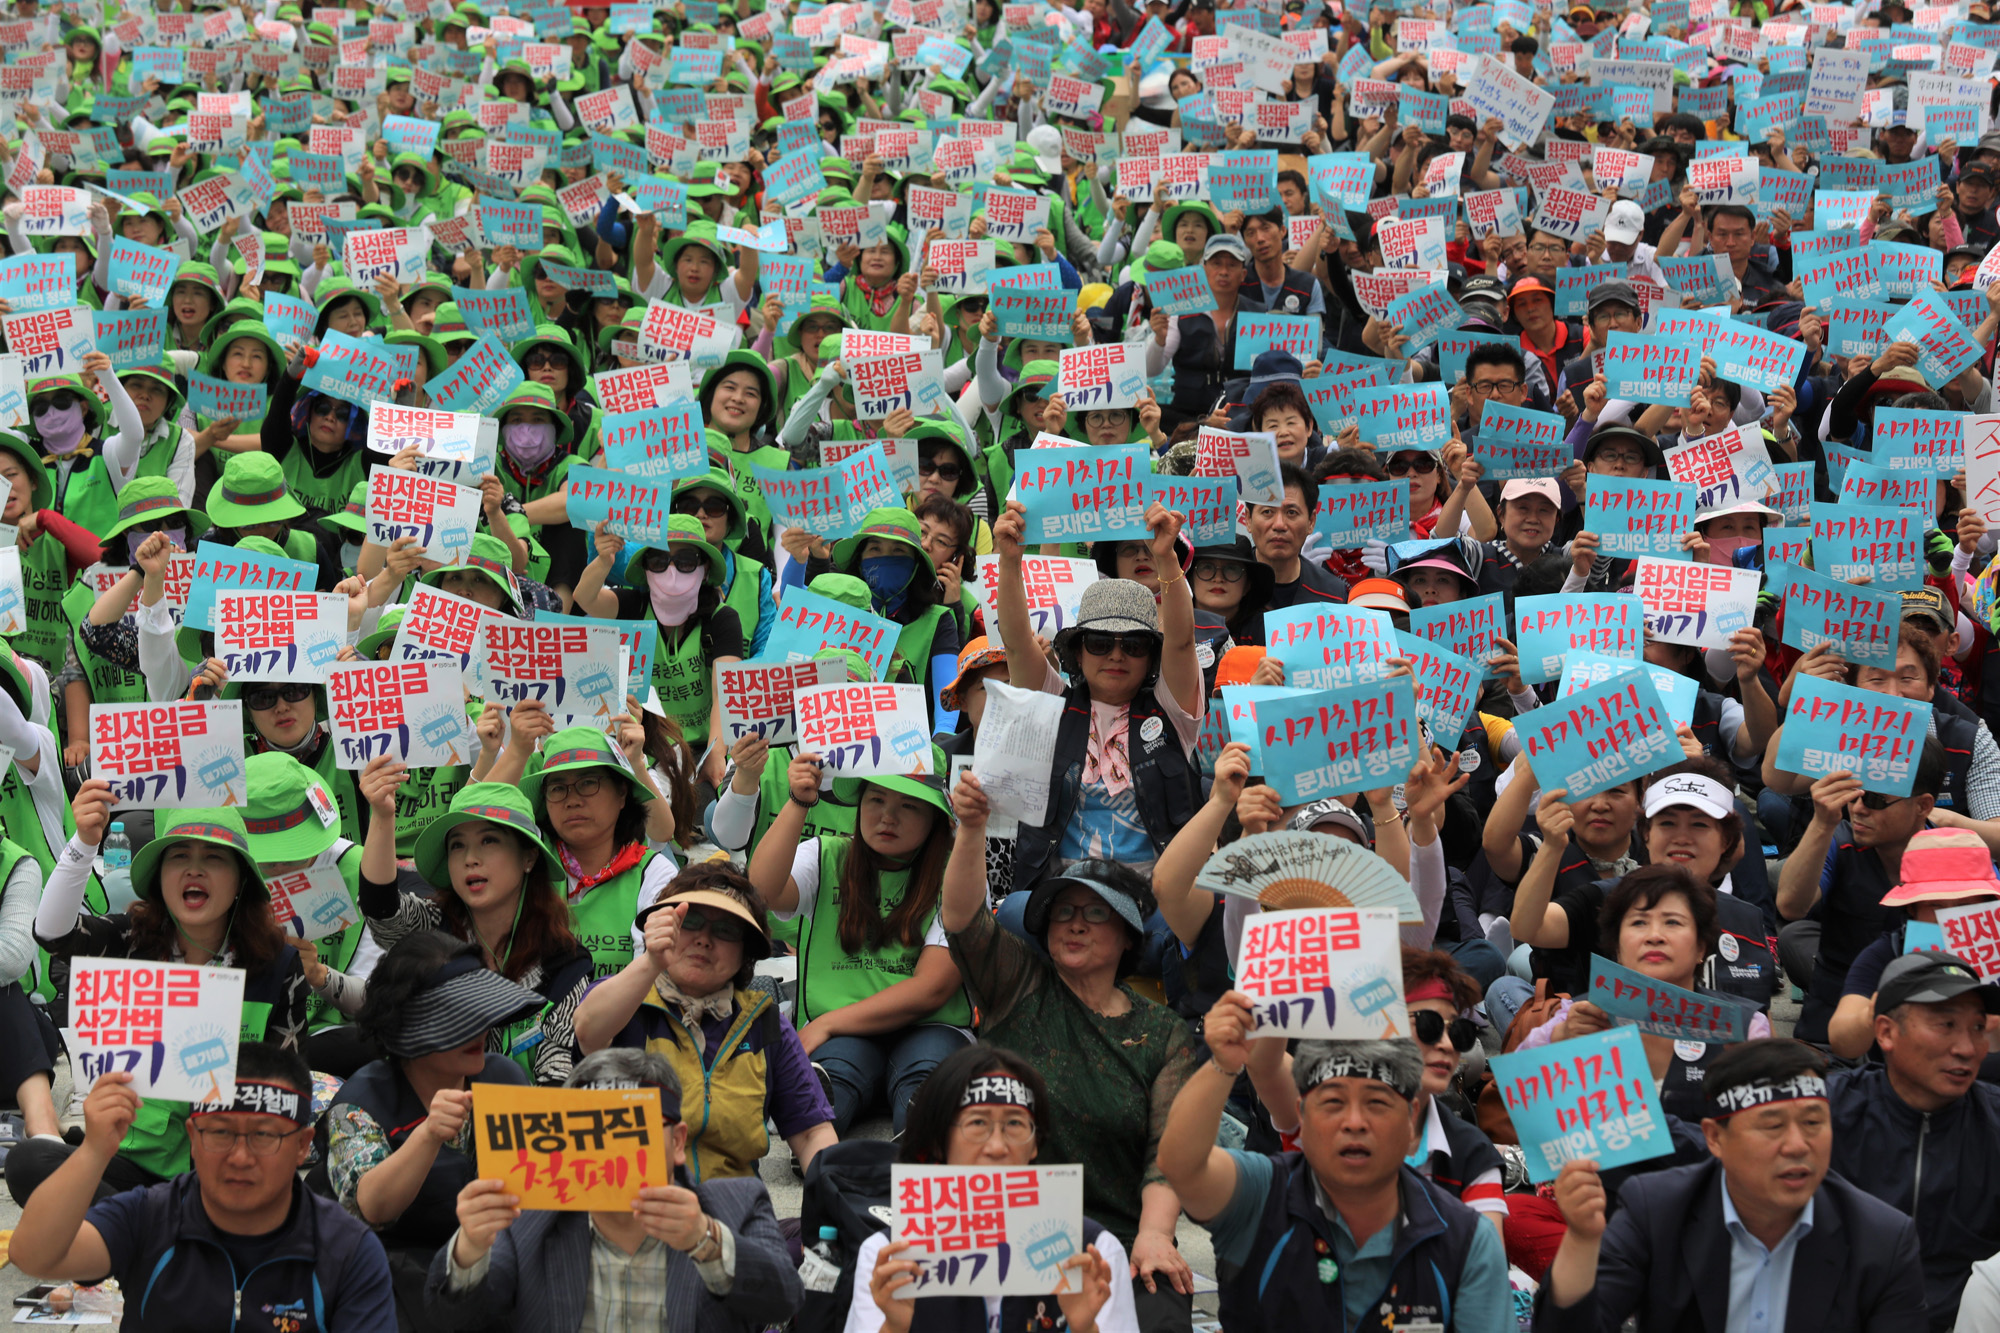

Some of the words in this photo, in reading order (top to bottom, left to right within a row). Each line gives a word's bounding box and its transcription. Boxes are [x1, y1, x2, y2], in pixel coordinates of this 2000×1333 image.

[189, 114, 232, 128] 최저임금
[1257, 102, 1300, 116] 최저임금
[489, 144, 535, 159] 최저임금
[1162, 155, 1210, 173] 최저임금
[1596, 150, 1638, 167] 최저임금
[1692, 159, 1742, 175] 최저임금
[24, 189, 76, 203] 최저임금
[1467, 191, 1503, 210] 최저임금
[1548, 187, 1596, 211] 최저임금
[352, 230, 408, 252] 최저임금
[113, 249, 169, 272] 사기치지
[354, 248, 397, 266] 삭감법
[1804, 252, 1868, 286] 사기치지
[996, 297, 1067, 311] 사기치지
[1392, 289, 1441, 327] 사기치지
[7, 309, 73, 338] 최저임금
[650, 305, 716, 337] 최저임금
[1912, 298, 1972, 357] 사기치지
[12, 332, 59, 356] 삭감법
[644, 324, 694, 350] 삭감법
[1720, 331, 1796, 361] 사기치지
[1062, 345, 1125, 371] 최저임금
[1608, 345, 1690, 365] 사기치지
[1748, 354, 1795, 378] 마라!
[1920, 332, 1962, 373] 마라!
[437, 342, 494, 406] 사기치지
[472, 354, 509, 396] 마라!
[599, 365, 670, 398] 최저임금
[855, 353, 922, 382] 최저임금
[1062, 367, 1110, 388] 삭감법
[1643, 366, 1694, 384] 마라!
[1723, 362, 1762, 384] 문재인
[858, 375, 908, 399] 삭감법
[1064, 381, 1113, 409] 폐기
[1619, 381, 1661, 397] 문재인
[375, 407, 454, 429] 최저임금
[1360, 391, 1437, 418] 사기치지
[1398, 407, 1445, 429] 마라!
[608, 413, 690, 446] 사기치지
[1377, 429, 1419, 447] 문재인
[1420, 424, 1447, 442] 정부
[1485, 416, 1557, 440] 사기치지
[1877, 419, 1961, 439] 사기치지
[646, 432, 699, 459] 마라!
[671, 449, 702, 470] 정부
[1669, 430, 1743, 475] 최저임금
[1021, 456, 1132, 491] 사기치지
[372, 473, 456, 508] 최저임금
[571, 481, 658, 507] 사기치지
[864, 488, 895, 509] 정부
[1072, 482, 1143, 512] 마라!
[1151, 486, 1222, 507] 기치지
[1589, 489, 1682, 511] 사기치지
[1845, 478, 1927, 500] 사기치지
[371, 497, 434, 525] 삭감법
[608, 506, 662, 528] 마라!
[787, 496, 841, 519] 마라!
[1042, 508, 1102, 538] 문재인
[1105, 505, 1145, 530] 정부
[1354, 505, 1404, 528] 마라!
[1331, 526, 1374, 547] 문재인
[1627, 514, 1688, 535] 마라!
[1815, 517, 1908, 542] 사기치지
[1852, 542, 1915, 565] 마라!
[198, 560, 302, 591] 사기치지
[1640, 564, 1733, 591] 최저임금
[1879, 562, 1916, 582] 정부
[221, 594, 318, 622] 최저임금
[1640, 587, 1707, 613] 삭감법
[1791, 582, 1884, 622] 사기치지
[781, 604, 884, 647] 사기치지
[1271, 615, 1379, 648] 사기치지
[1417, 605, 1494, 644] 사기치지
[1521, 604, 1628, 634] 사기치지
[1824, 619, 1890, 644] 마라!
[221, 621, 294, 649] 삭감법
[485, 626, 588, 653] 최저임금
[1570, 628, 1635, 650] 마라!
[487, 653, 562, 680] 삭감법
[1323, 641, 1392, 667] 마라!
[330, 662, 429, 703] 최저임금
[491, 676, 566, 707] 폐기
[721, 663, 818, 695] 최저임금
[334, 698, 404, 733] 삭감법
[799, 685, 898, 723] 최저임금
[1793, 697, 1912, 732] 사기치지
[95, 704, 207, 742] 최저임금
[801, 716, 876, 746] 삭감법
[1265, 692, 1394, 748] 사기치지
[1529, 684, 1640, 757] 사기치지
[1587, 707, 1662, 759] 마라!
[341, 724, 410, 766] 폐기
[1328, 719, 1408, 762] 마라!
[1839, 733, 1914, 763] 마라!
[97, 738, 182, 775] 삭감법
[1565, 751, 1630, 797] 문재인
[1625, 729, 1671, 761] 정부
[1803, 749, 1862, 778] 문재인
[1866, 756, 1908, 782] 정부
[108, 765, 187, 802] 폐기
[1294, 759, 1361, 798] 문재인
[1364, 744, 1412, 776] 정부
[1246, 912, 1360, 961] 최저임금
[75, 969, 200, 1008] 최저임금
[1241, 954, 1331, 996] 삭감법
[1595, 975, 1721, 1019] 사기치지
[75, 1009, 163, 1046] 삭감법
[1639, 1020, 1684, 1036] 재인
[79, 1041, 165, 1088] 폐기
[1505, 1046, 1623, 1111] 사기치지
[1556, 1078, 1647, 1132] 마라!
[486, 1106, 649, 1153] 비정규직
[1540, 1130, 1601, 1171] 문재인
[1598, 1109, 1656, 1151] 정부
[510, 1149, 648, 1204] 철폐!
[899, 1170, 1039, 1215] 최저임금
[901, 1212, 1007, 1254] 삭감법
[911, 1242, 1011, 1291] 폐기
